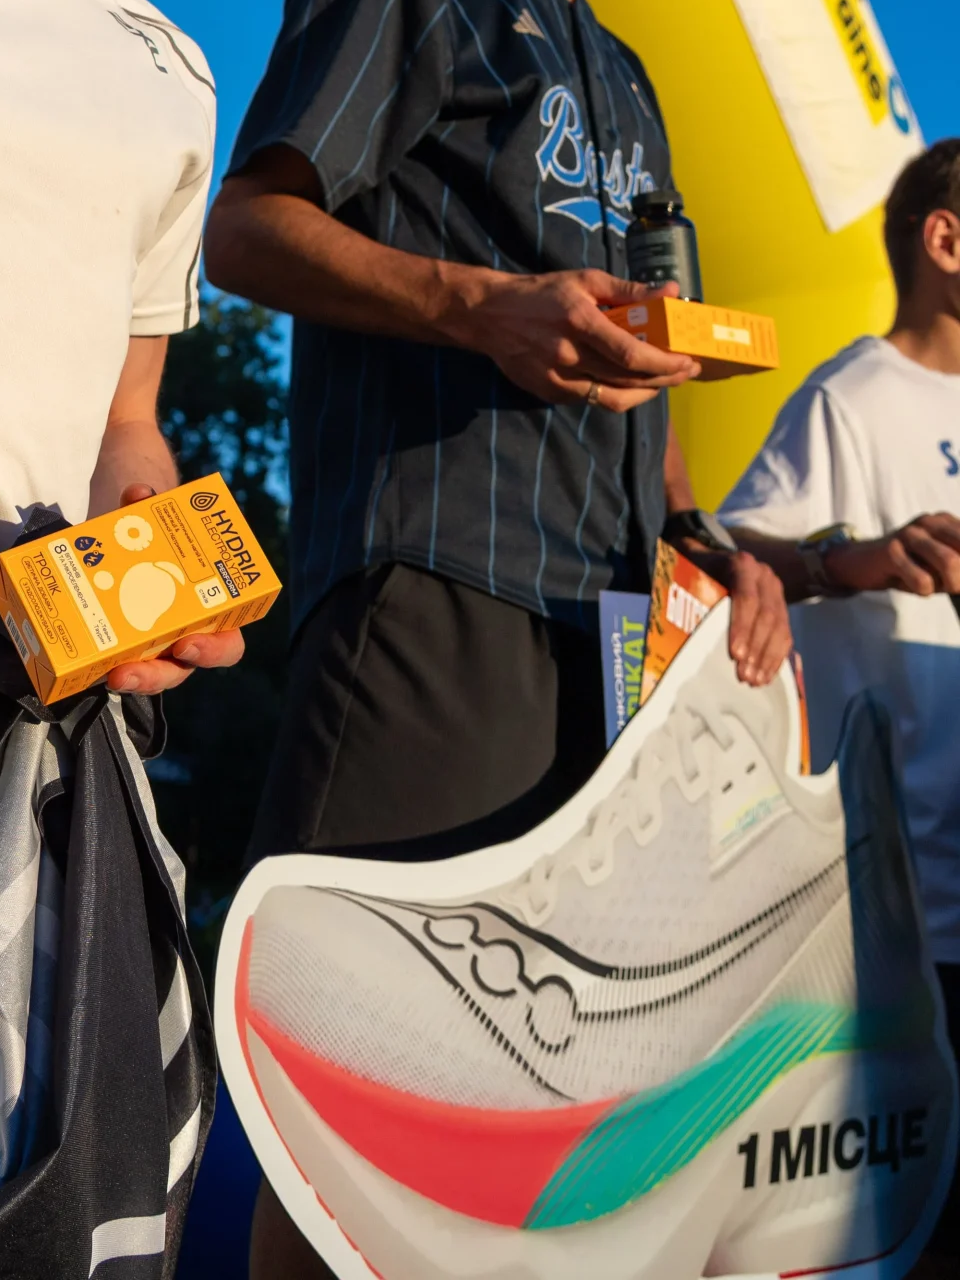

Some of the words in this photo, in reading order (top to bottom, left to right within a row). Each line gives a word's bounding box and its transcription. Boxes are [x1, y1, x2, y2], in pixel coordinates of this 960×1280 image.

[535, 84, 656, 211] Bosto
[33, 551, 61, 596] ТРОПІК
[53, 542, 67, 555] 8
[200, 515, 247, 590] ELECTROLYTES
[210, 509, 261, 586] HYDRIA
[206, 585, 221, 597] 5
[216, 562, 238, 596] PERFORM
[56, 624, 65, 635] БЕЗ
[608, 632, 627, 730] НКОВИЙ
[737, 1132, 759, 1189] 1
[769, 1107, 929, 1184] МІСЦЕ
